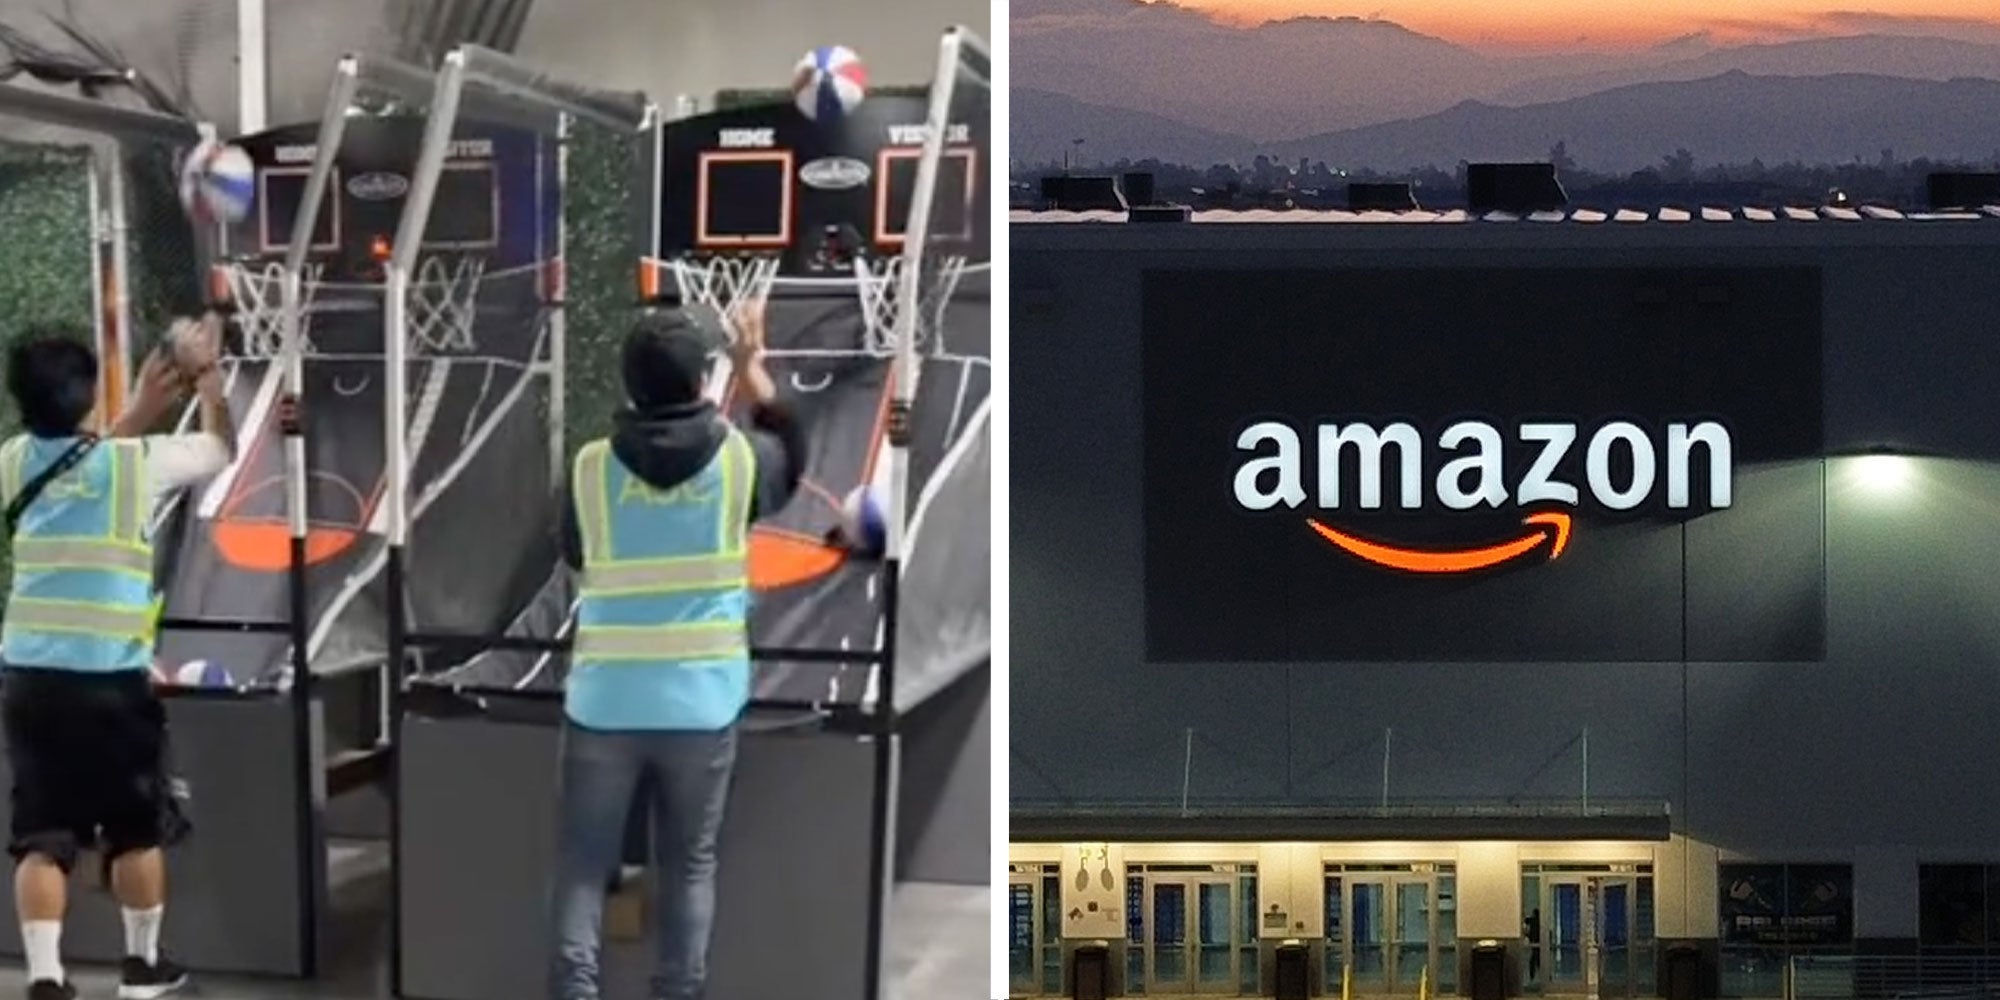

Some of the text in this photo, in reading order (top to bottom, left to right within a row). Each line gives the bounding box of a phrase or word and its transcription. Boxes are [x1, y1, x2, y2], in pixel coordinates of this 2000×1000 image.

[718, 128, 775, 147] HOME
[888, 124, 969, 143] VISOR
[274, 145, 318, 163] HOM
[1233, 421, 1733, 510] amazon
